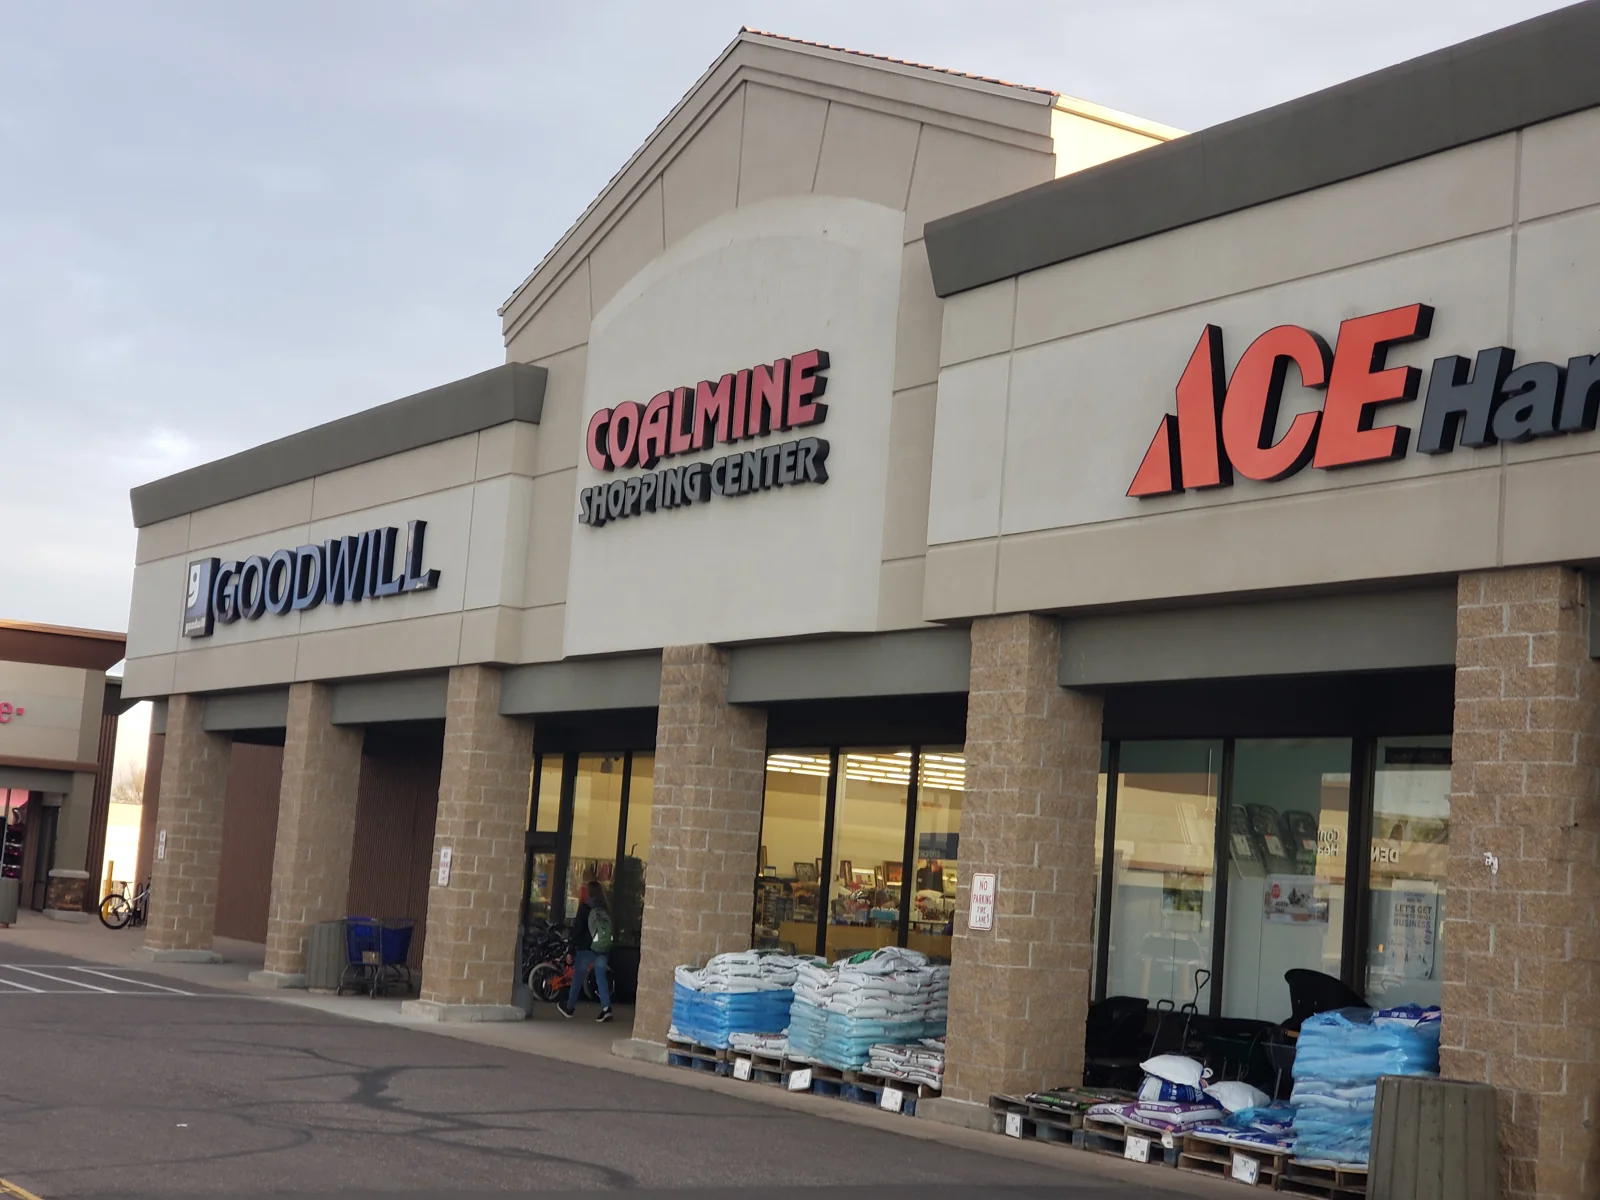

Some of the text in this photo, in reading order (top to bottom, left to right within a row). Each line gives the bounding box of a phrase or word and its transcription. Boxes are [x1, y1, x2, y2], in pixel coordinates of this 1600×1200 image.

[586, 349, 830, 471] COALMINE
[1126, 303, 1600, 498] ACE Har
[578, 436, 830, 527] SHOPPING CENTER
[212, 519, 441, 624] GOODWILL
[972, 893, 992, 905] PARKING
[979, 880, 988, 891] NO
[1394, 903, 1433, 915] LET'S GET
[1393, 918, 1431, 929] BUSINESS
